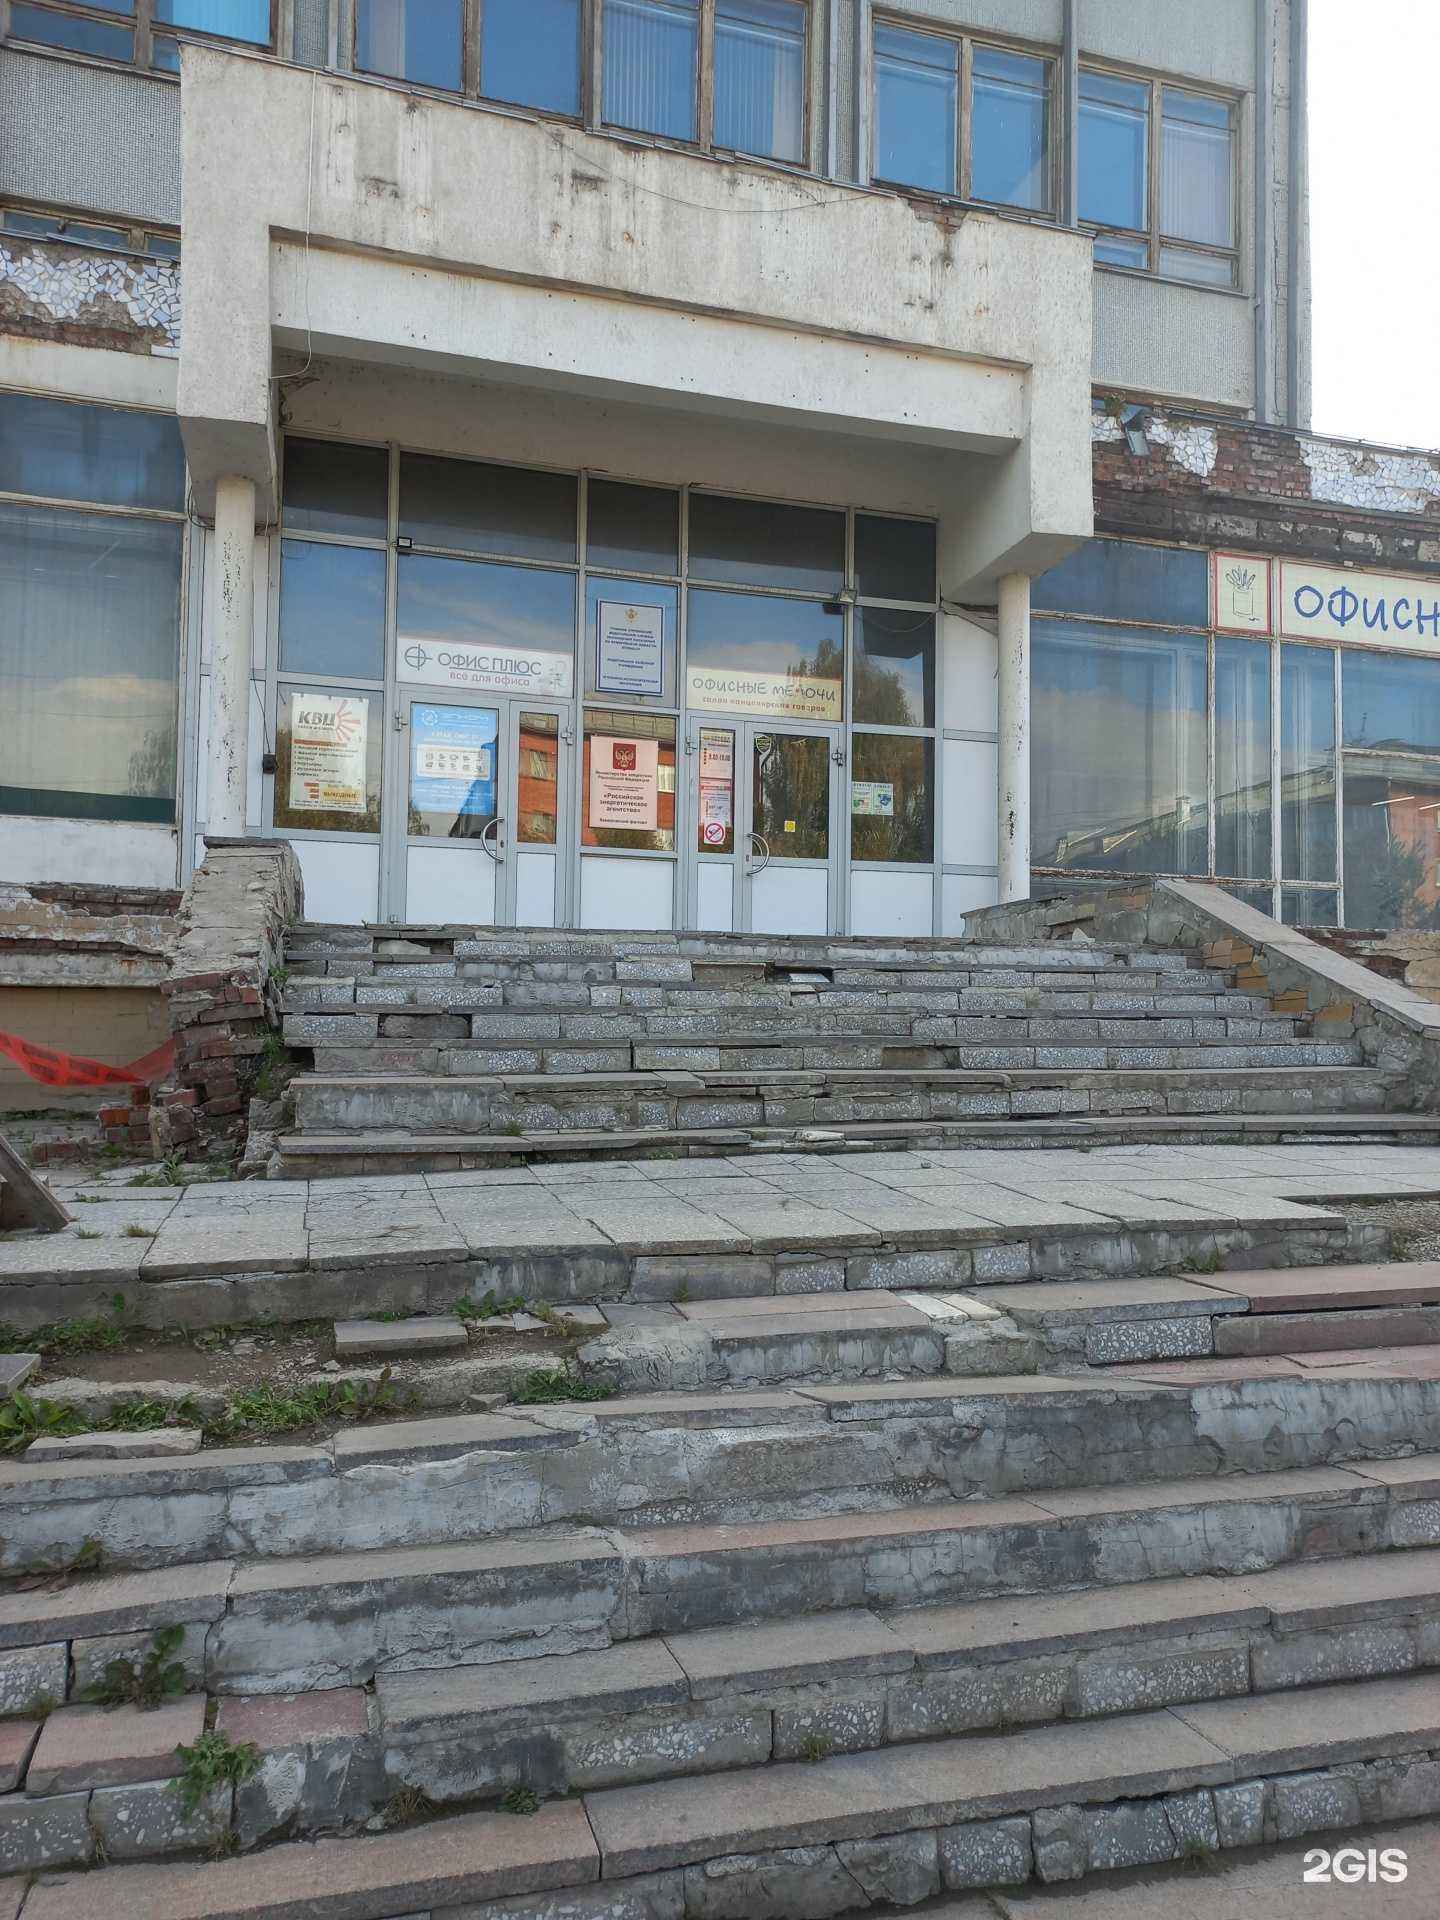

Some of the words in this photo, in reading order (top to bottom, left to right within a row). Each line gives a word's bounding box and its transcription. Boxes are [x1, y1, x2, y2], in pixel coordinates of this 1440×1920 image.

[1293, 584, 1440, 638] ОФИСН
[437, 652, 489, 670] ОФИС
[492, 658, 542, 676] ПЛЮС
[472, 673, 492, 683] для
[494, 675, 530, 688] офиса
[692, 678, 768, 695] ОФИСНЫЕ
[792, 703, 826, 713] товаров
